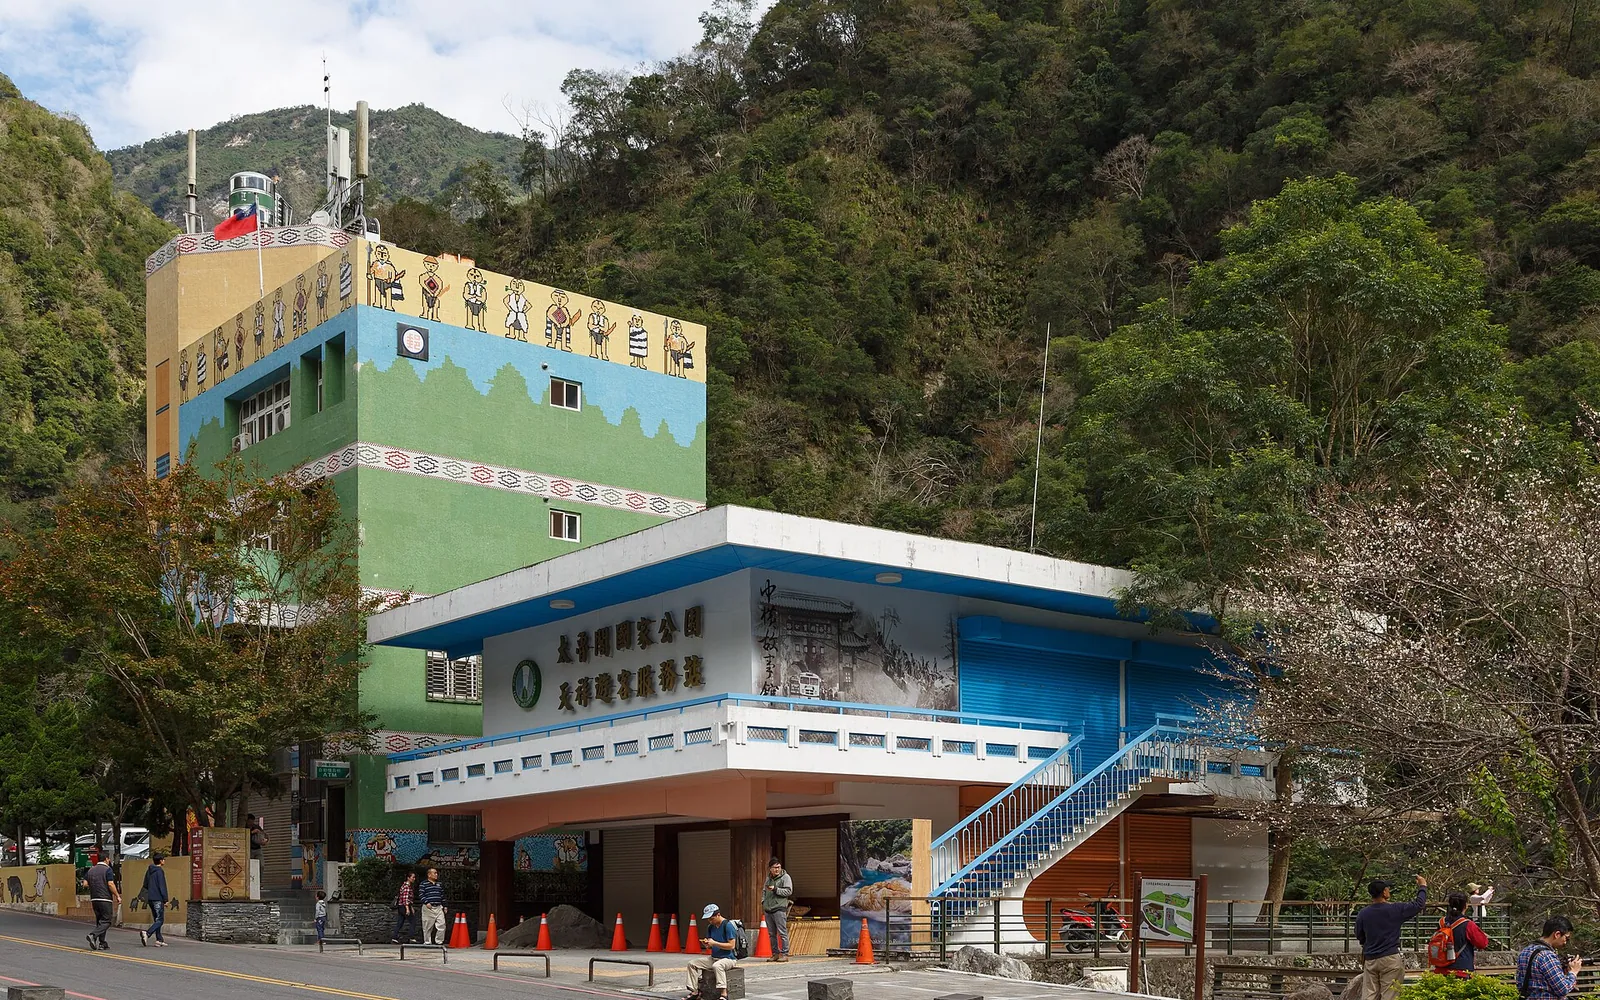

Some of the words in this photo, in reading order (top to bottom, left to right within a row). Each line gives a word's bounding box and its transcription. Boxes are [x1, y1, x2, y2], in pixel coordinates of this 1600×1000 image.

[556, 605, 703, 664] 太魯閣國家公園
[557, 654, 703, 711] 天祥遊客服務站
